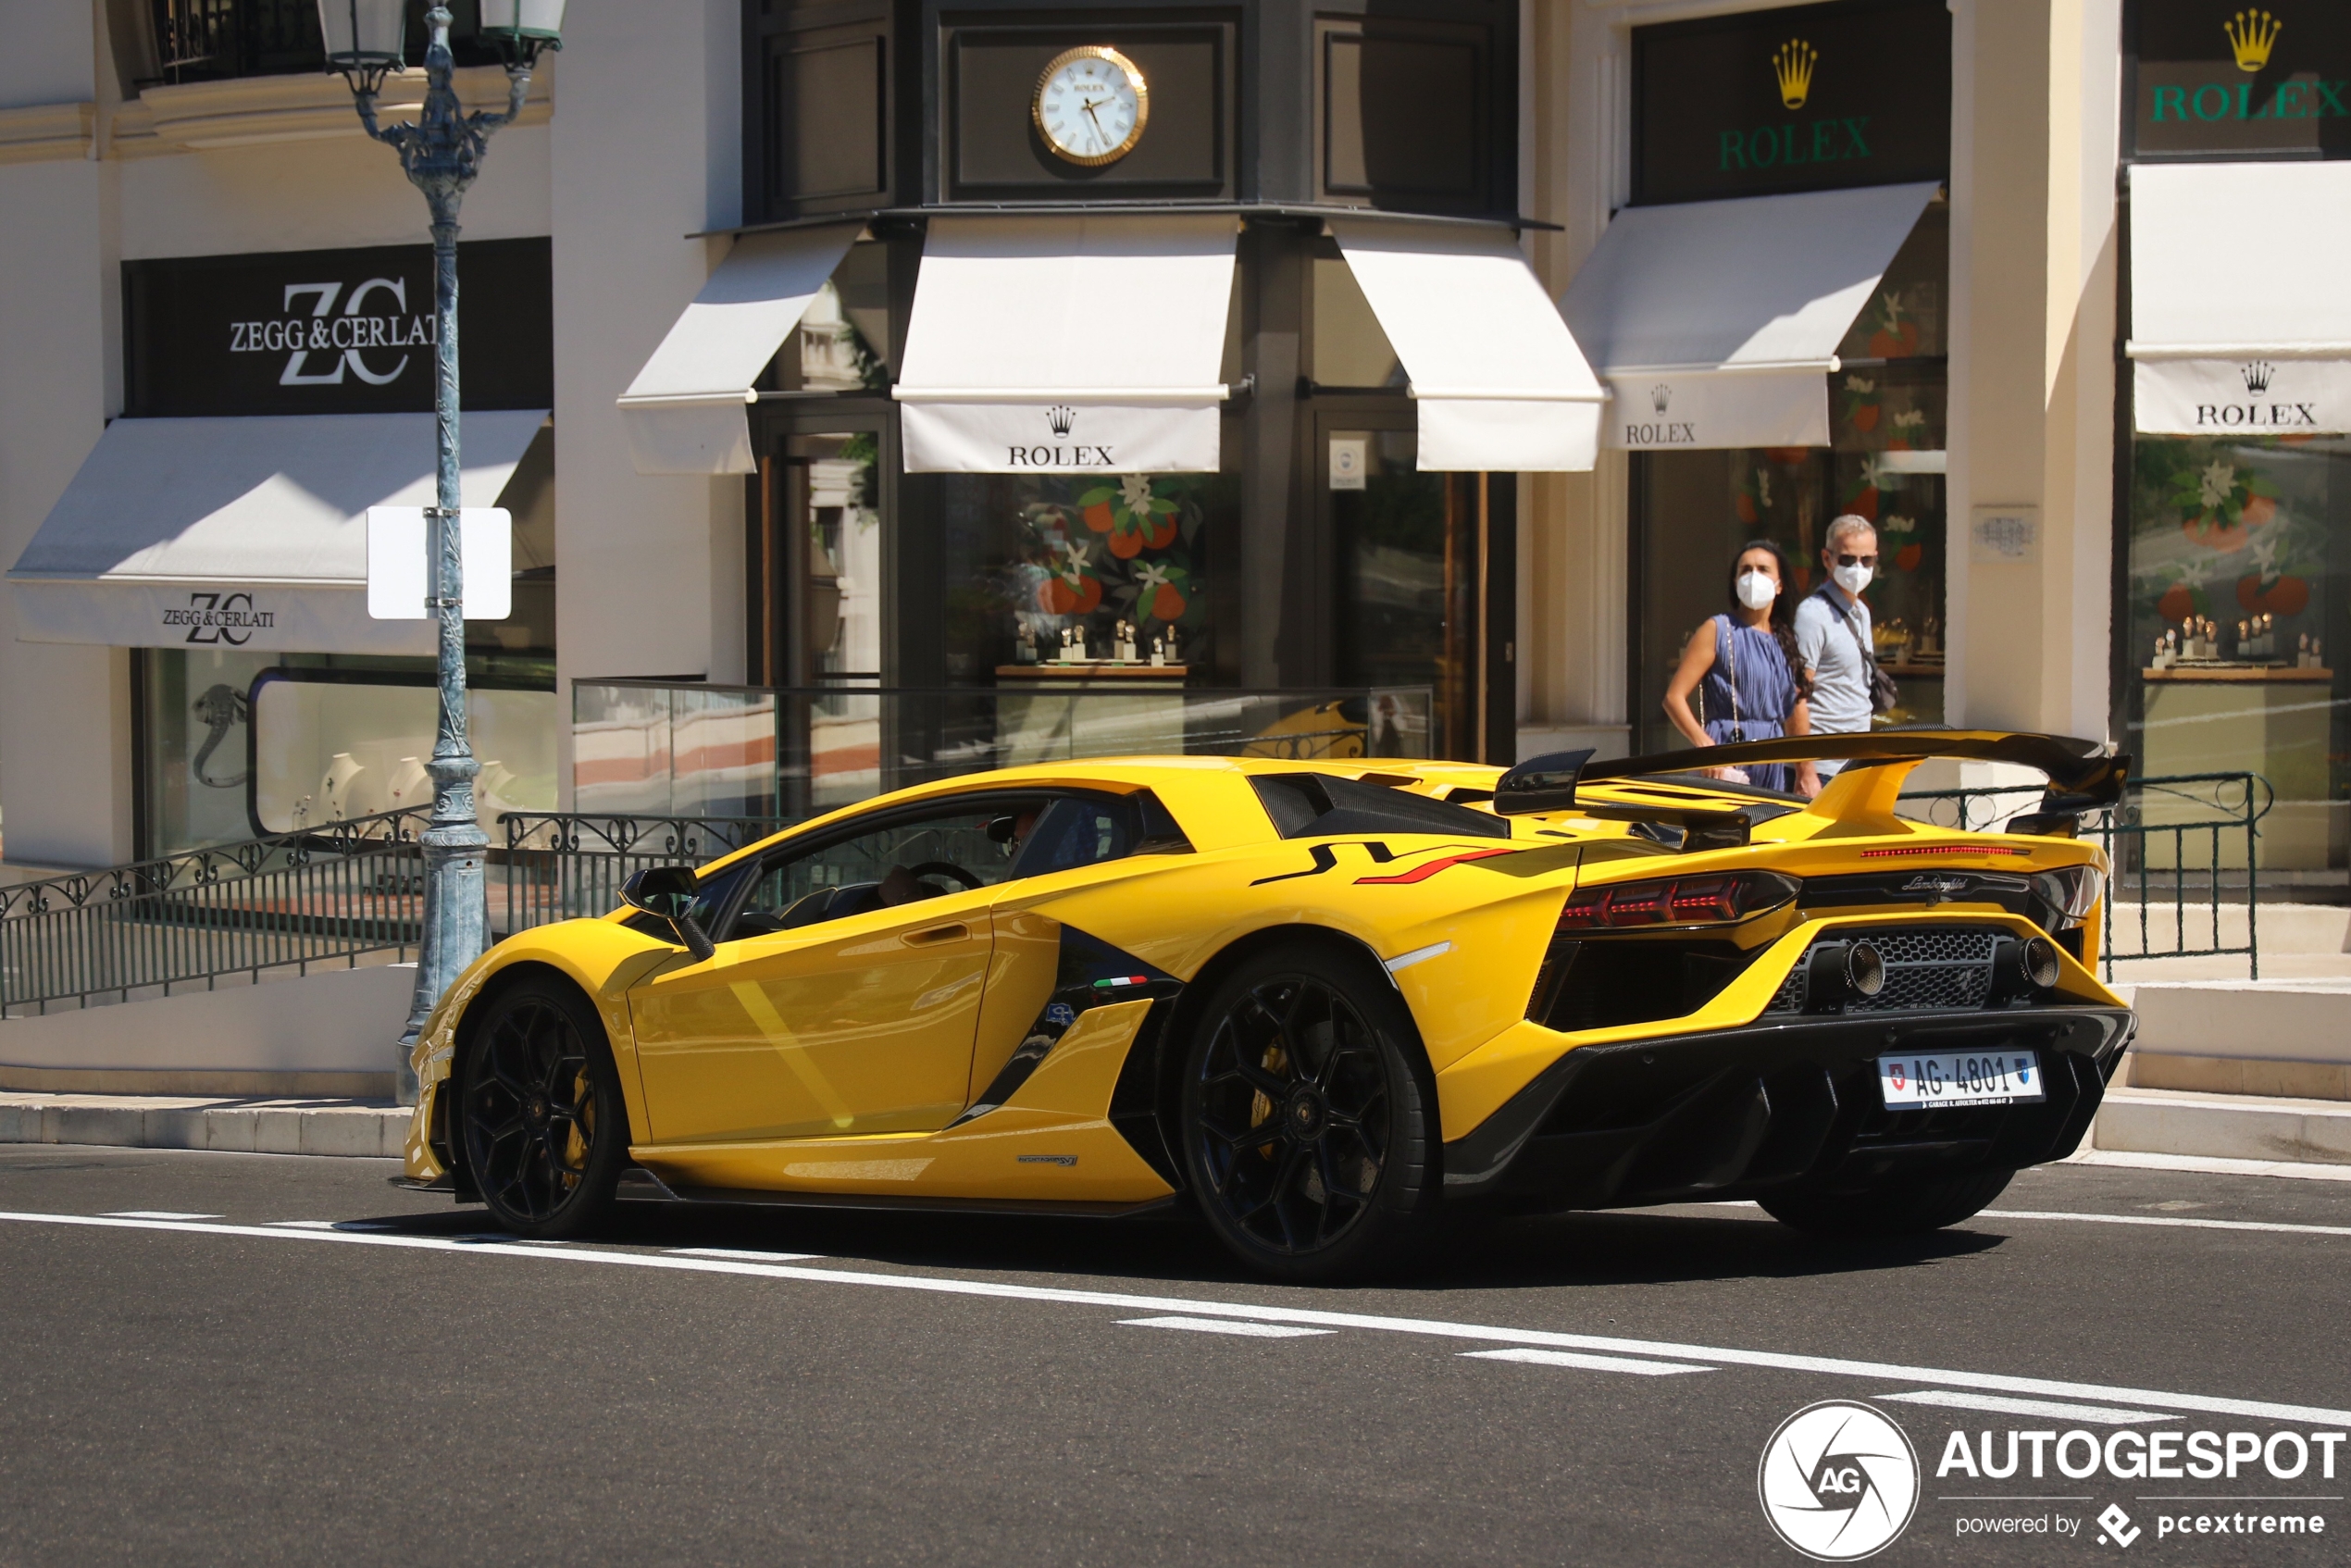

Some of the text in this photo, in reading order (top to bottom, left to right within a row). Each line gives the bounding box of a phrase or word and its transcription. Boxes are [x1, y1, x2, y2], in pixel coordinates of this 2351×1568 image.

[1075, 83, 1104, 92] ROLEX
[2151, 81, 2351, 122] ROLEX
[1719, 117, 1873, 170] ROLEX
[2196, 404, 2317, 426] ROLEX
[1626, 422, 1696, 444] ROLEX
[1007, 446, 1115, 466] ROLEX
[1901, 876, 1969, 892] Lamborghini
